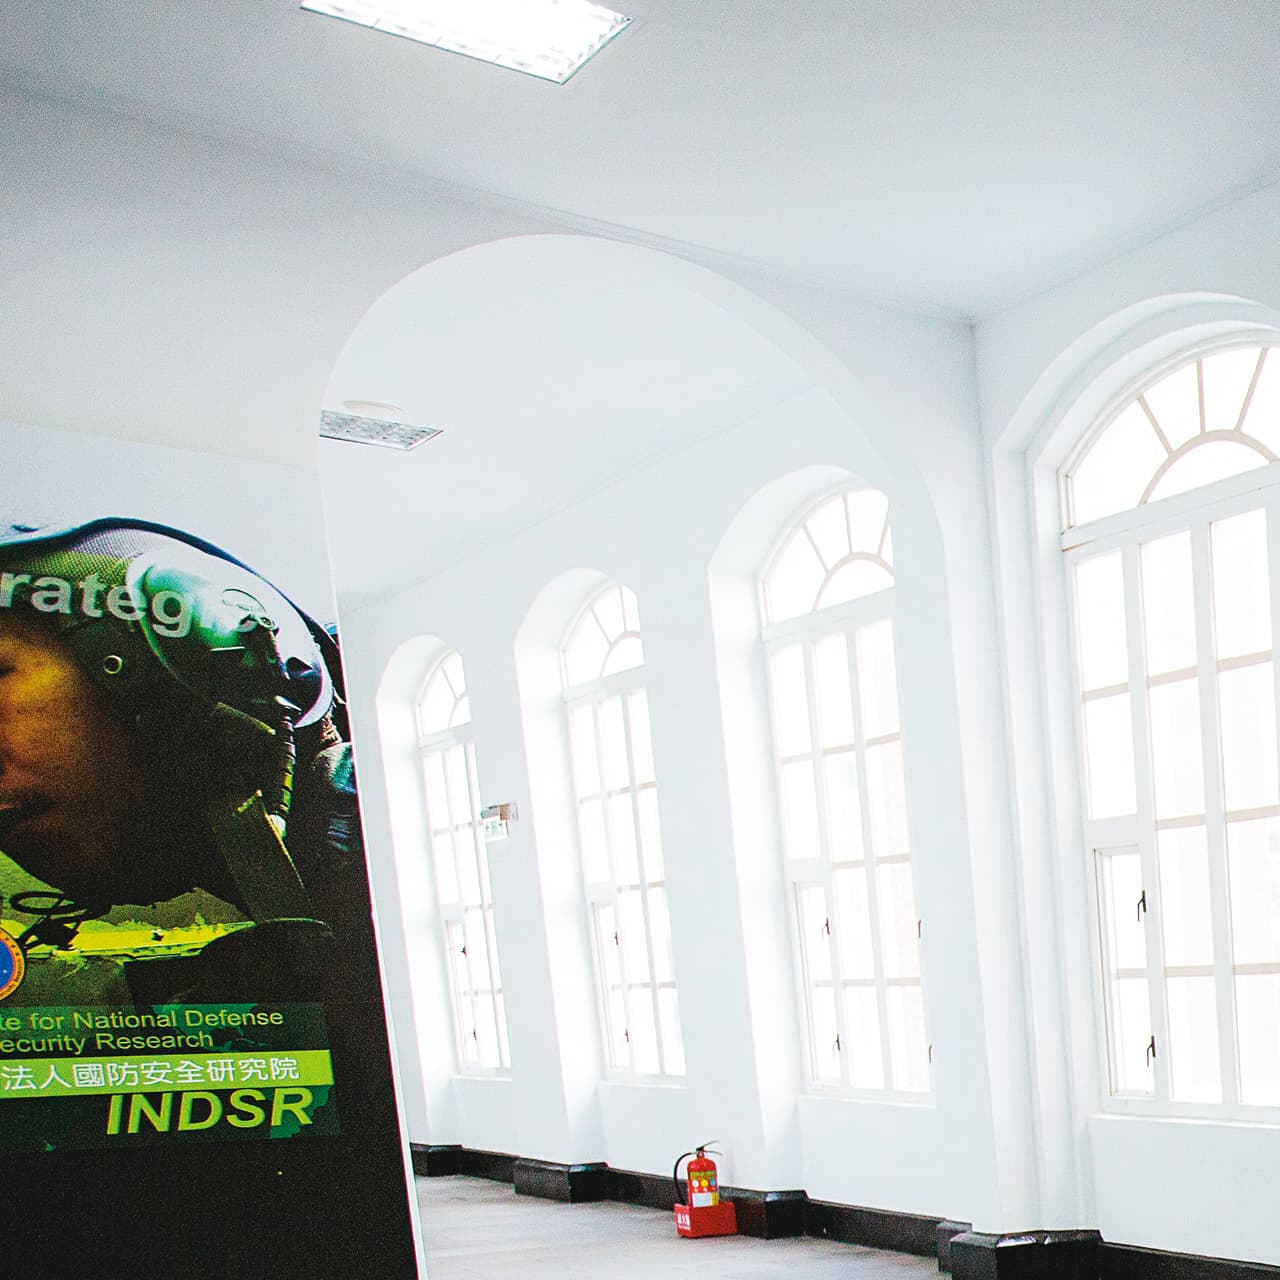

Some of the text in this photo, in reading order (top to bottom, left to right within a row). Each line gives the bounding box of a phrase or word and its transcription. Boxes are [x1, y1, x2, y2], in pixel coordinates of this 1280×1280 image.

[30, 1012, 64, 1030] for
[74, 1010, 176, 1029] National
[185, 1009, 284, 1027] Defense
[96, 1031, 213, 1050] Research
[1, 1057, 300, 1090] 法人國防安全研究院
[106, 1087, 313, 1135] INDSR
